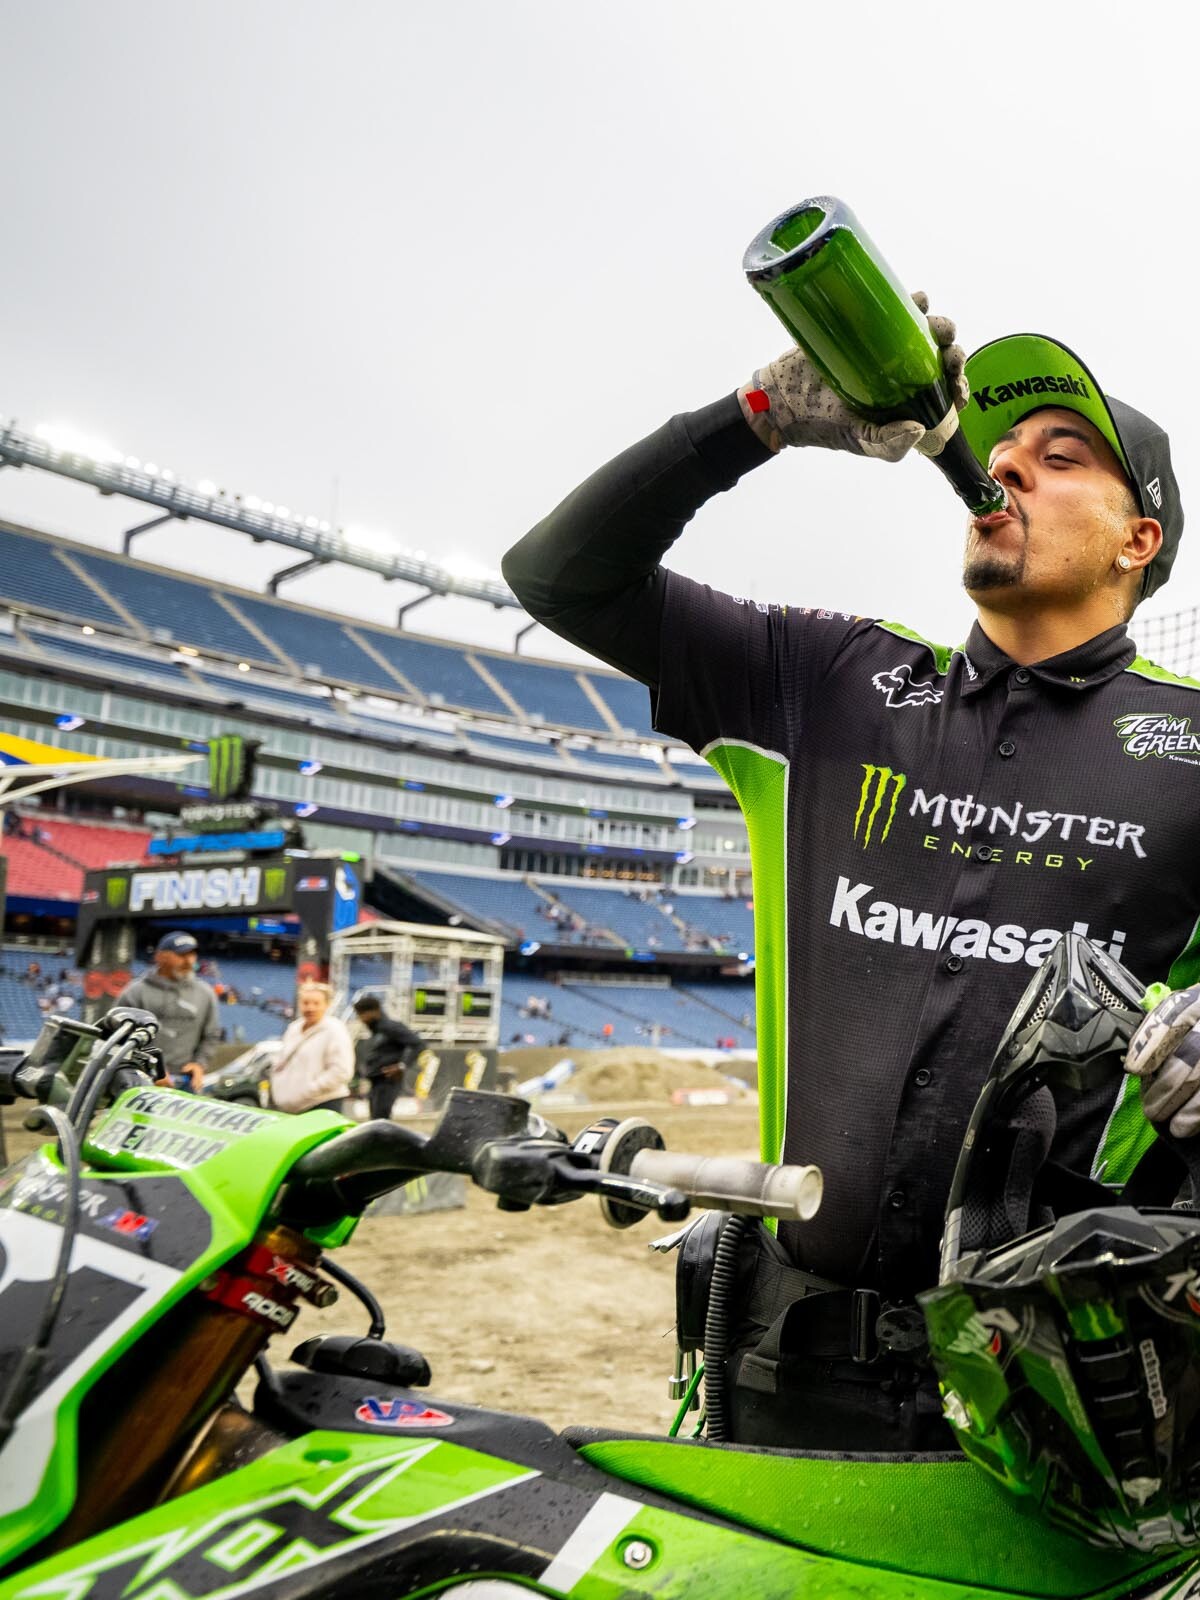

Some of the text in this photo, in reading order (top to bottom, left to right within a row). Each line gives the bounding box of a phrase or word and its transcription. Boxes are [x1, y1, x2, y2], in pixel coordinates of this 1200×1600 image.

[972, 373, 1090, 412] Kawasaki
[909, 788, 1147, 858] MONSTER
[923, 835, 1094, 871] ENERGY
[129, 867, 262, 912] FINISH
[363, 1396, 428, 1422] VP
